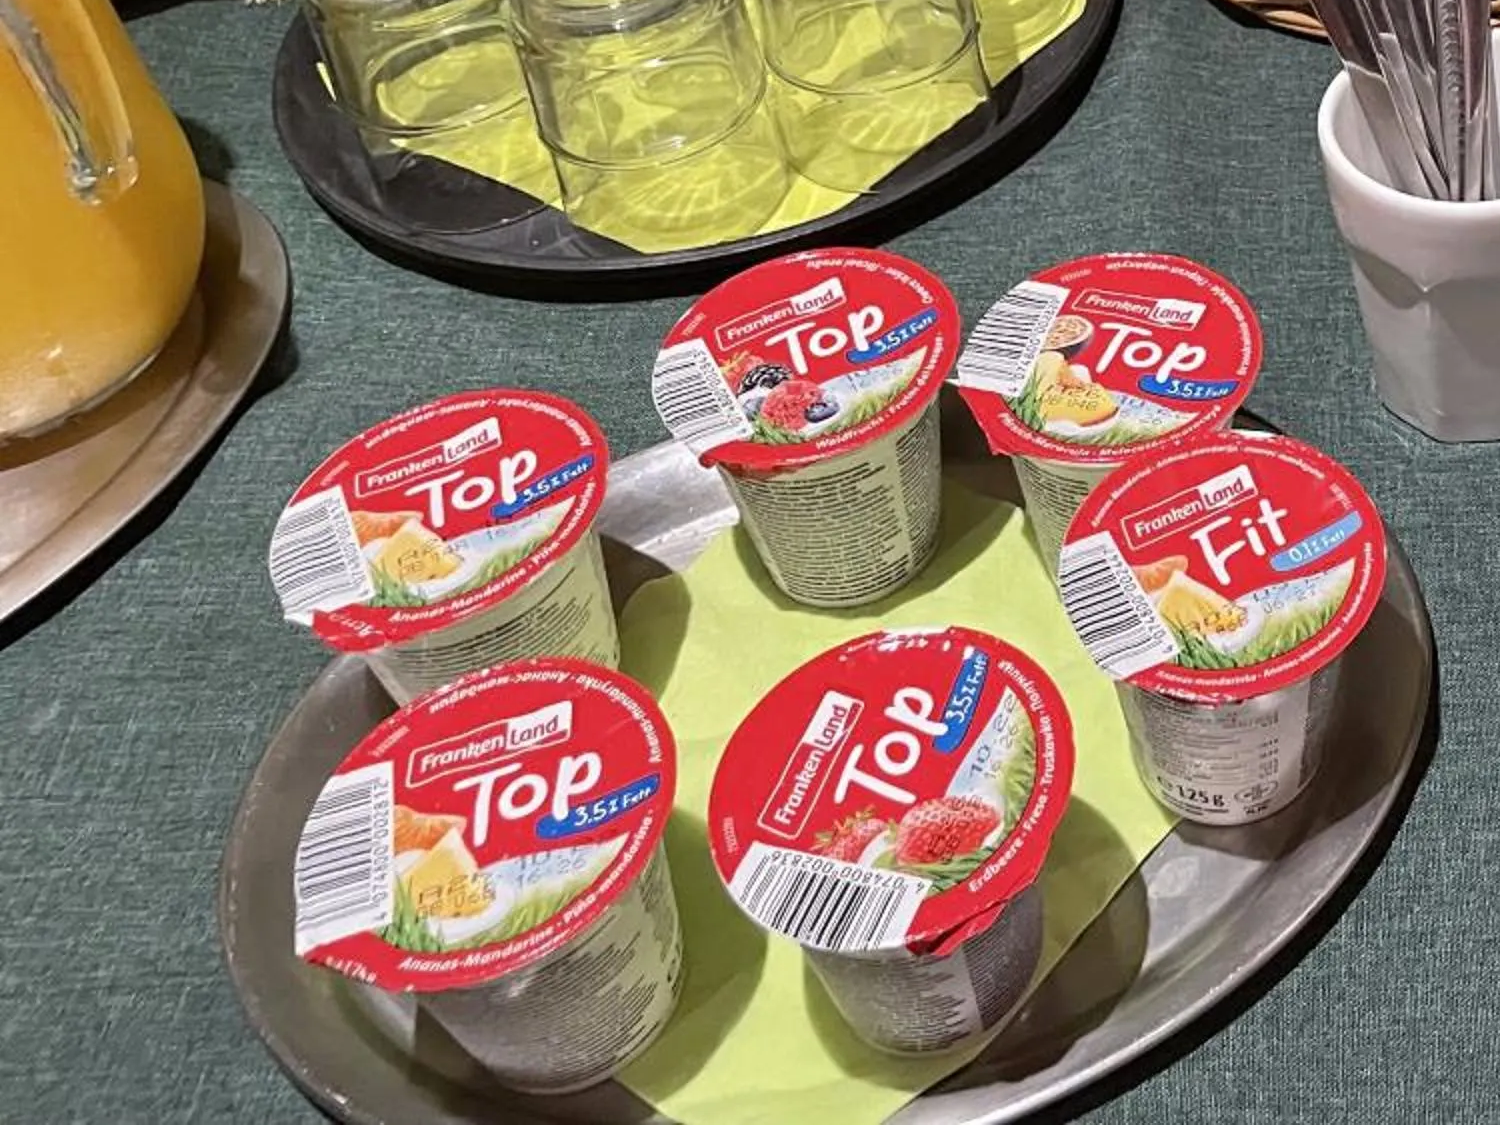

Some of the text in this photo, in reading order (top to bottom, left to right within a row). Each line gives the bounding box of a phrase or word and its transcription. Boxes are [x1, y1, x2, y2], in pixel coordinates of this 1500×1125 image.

[727, 309, 792, 340] Franken
[795, 288, 835, 315] Land
[1085, 294, 1194, 321] Franken Land
[765, 305, 884, 375] Top
[1095, 322, 1208, 384] Top
[366, 451, 442, 488] Franken
[446, 430, 490, 460] Land
[404, 449, 537, 528] Top
[1133, 501, 1202, 538] Franken
[1204, 479, 1244, 509] Land
[1190, 498, 1289, 586] Fit
[420, 736, 505, 771] Franken
[509, 716, 560, 746] Land
[774, 704, 850, 828] Franken Land
[834, 686, 950, 806] Top
[453, 751, 603, 848] Top
[967, 838, 1026, 893] Erdbeere
